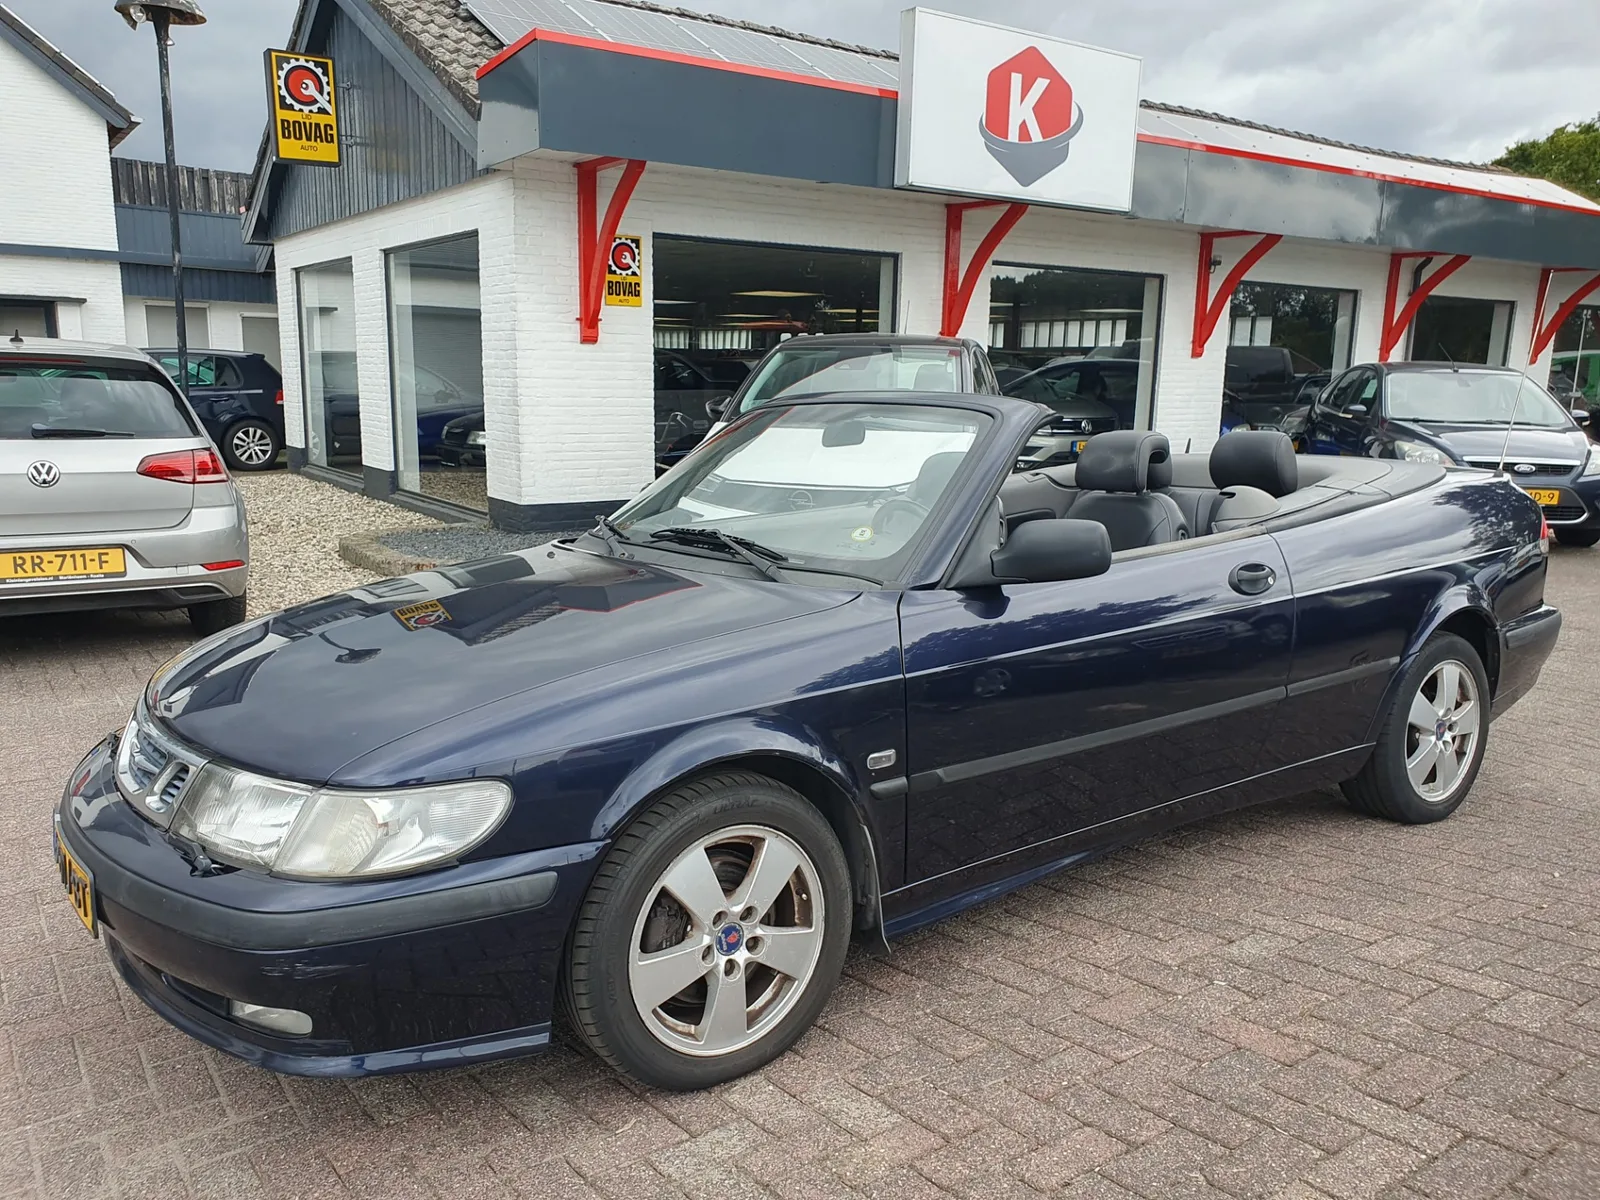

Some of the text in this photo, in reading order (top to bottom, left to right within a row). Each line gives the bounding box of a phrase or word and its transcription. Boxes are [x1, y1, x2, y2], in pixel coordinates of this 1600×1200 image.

[1007, 72, 1051, 142] K
[280, 118, 335, 144] BOVAG
[300, 144, 318, 152] AUTO
[607, 280, 640, 297] BOVAG
[12, 551, 110, 574] RR-711-F
